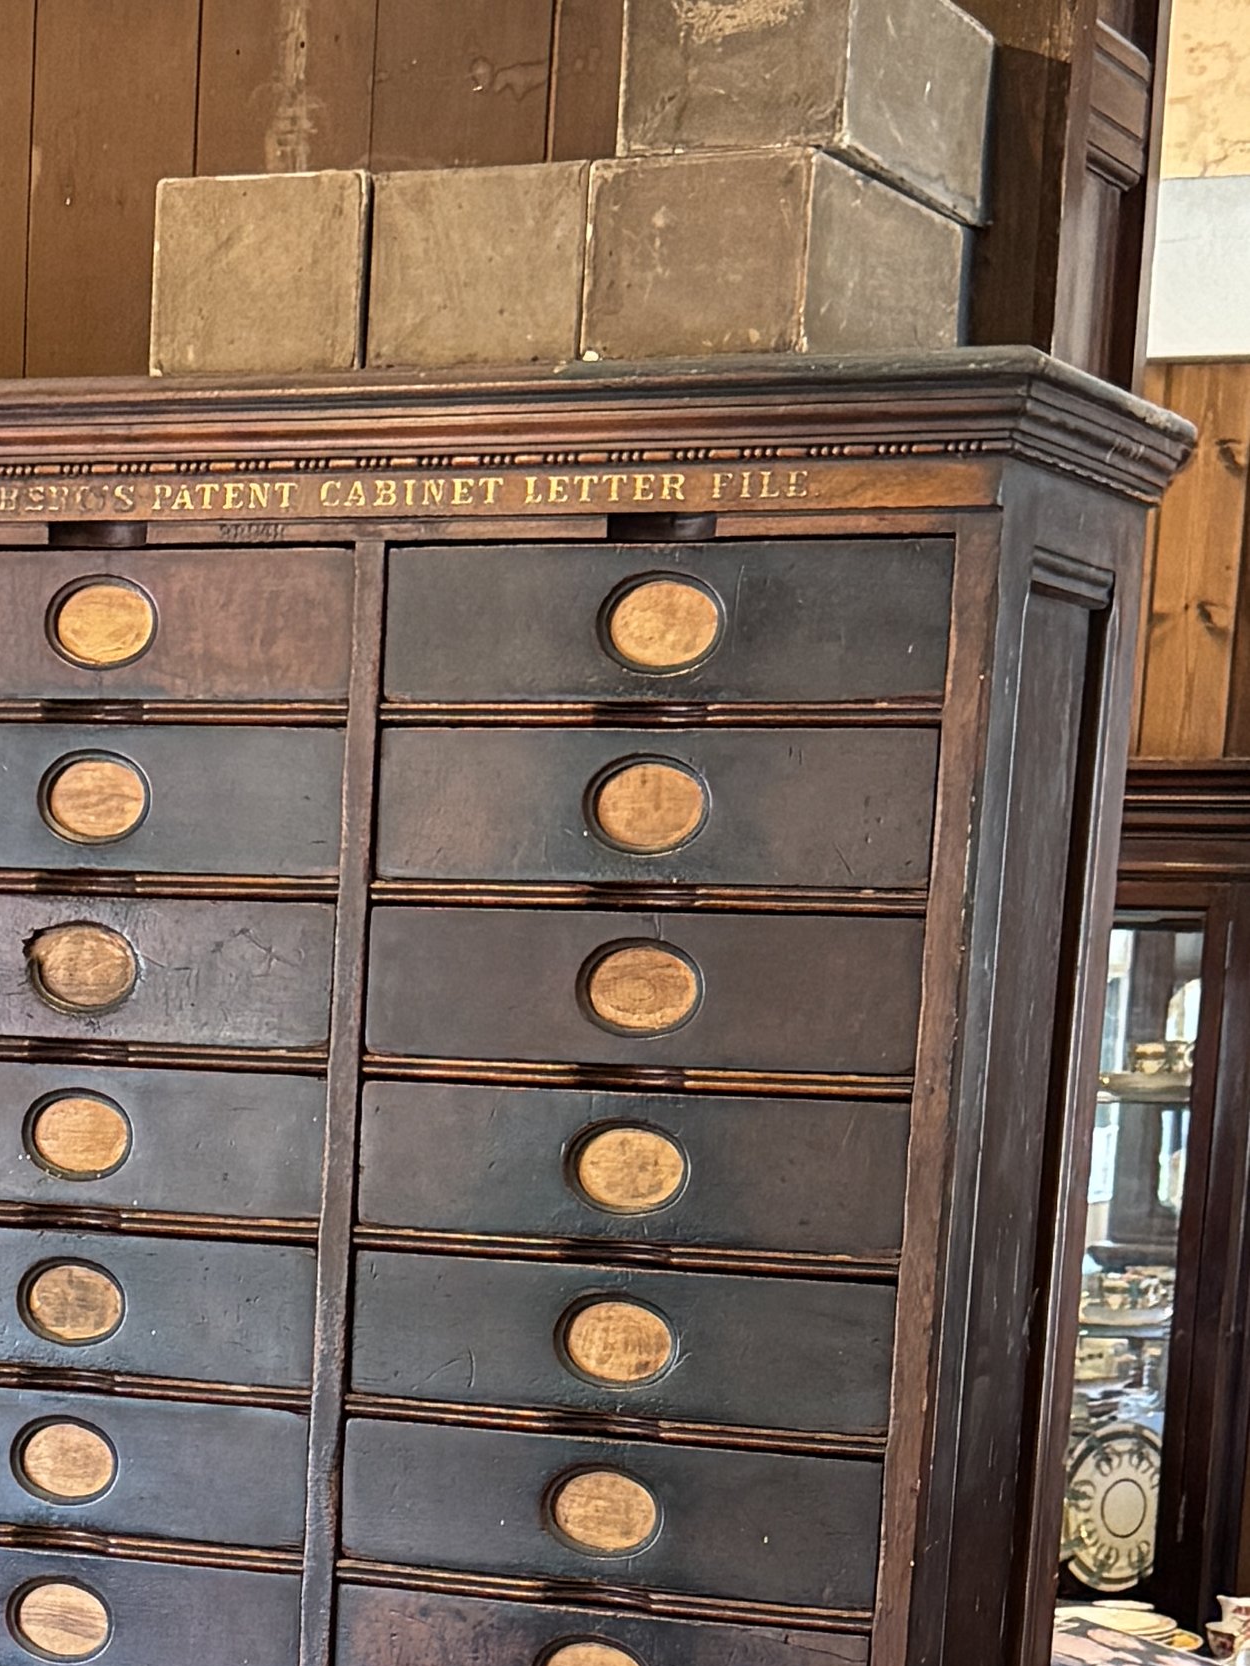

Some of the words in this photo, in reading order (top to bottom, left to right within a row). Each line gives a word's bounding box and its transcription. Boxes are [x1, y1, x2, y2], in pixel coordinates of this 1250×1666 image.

[151, 482, 298, 510] PATENT
[320, 477, 504, 507] CABINET
[524, 473, 686, 504] LETTER
